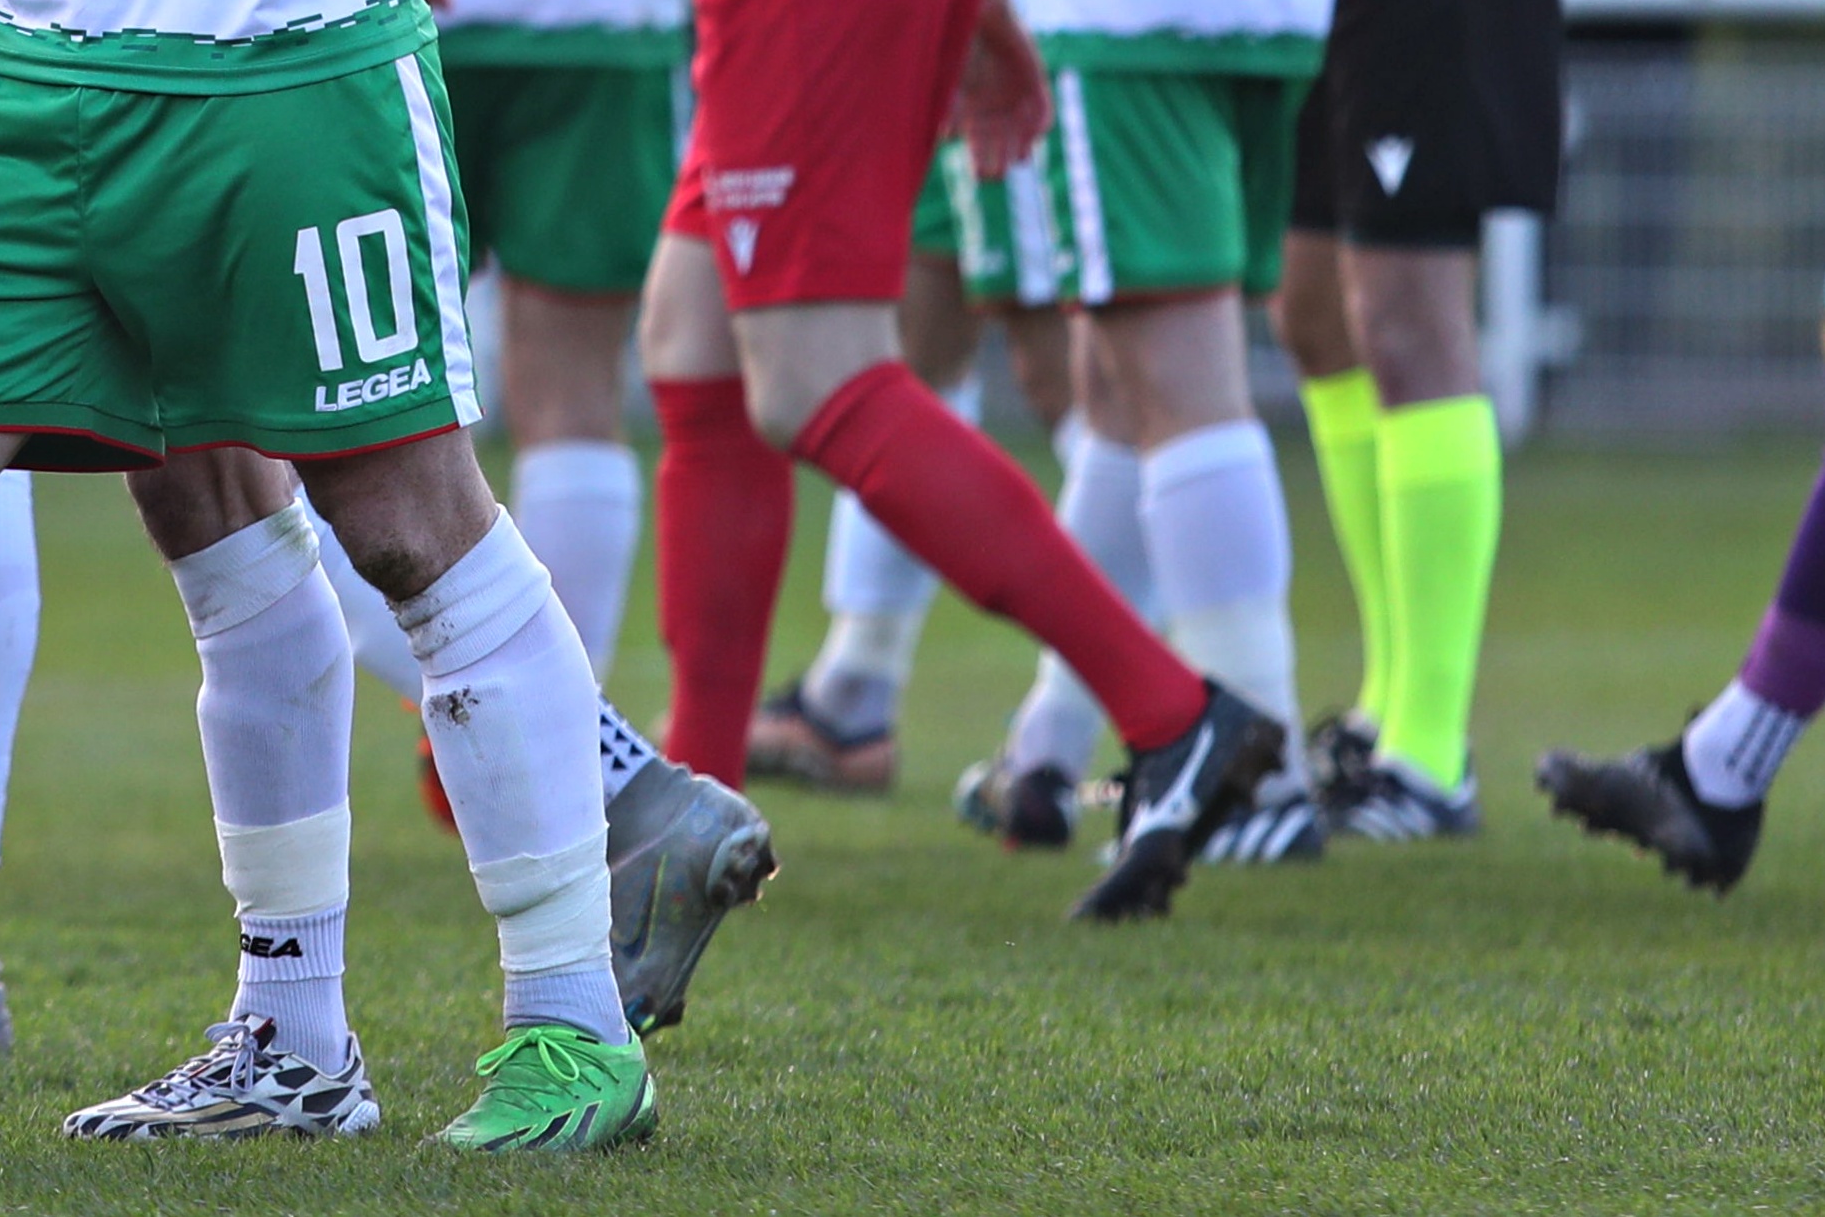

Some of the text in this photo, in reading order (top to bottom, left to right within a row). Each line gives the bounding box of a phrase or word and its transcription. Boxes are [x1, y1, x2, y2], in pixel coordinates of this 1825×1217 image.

[294, 208, 419, 371] 10
[315, 358, 432, 412] LEGEA
[240, 933, 303, 959] GEA
